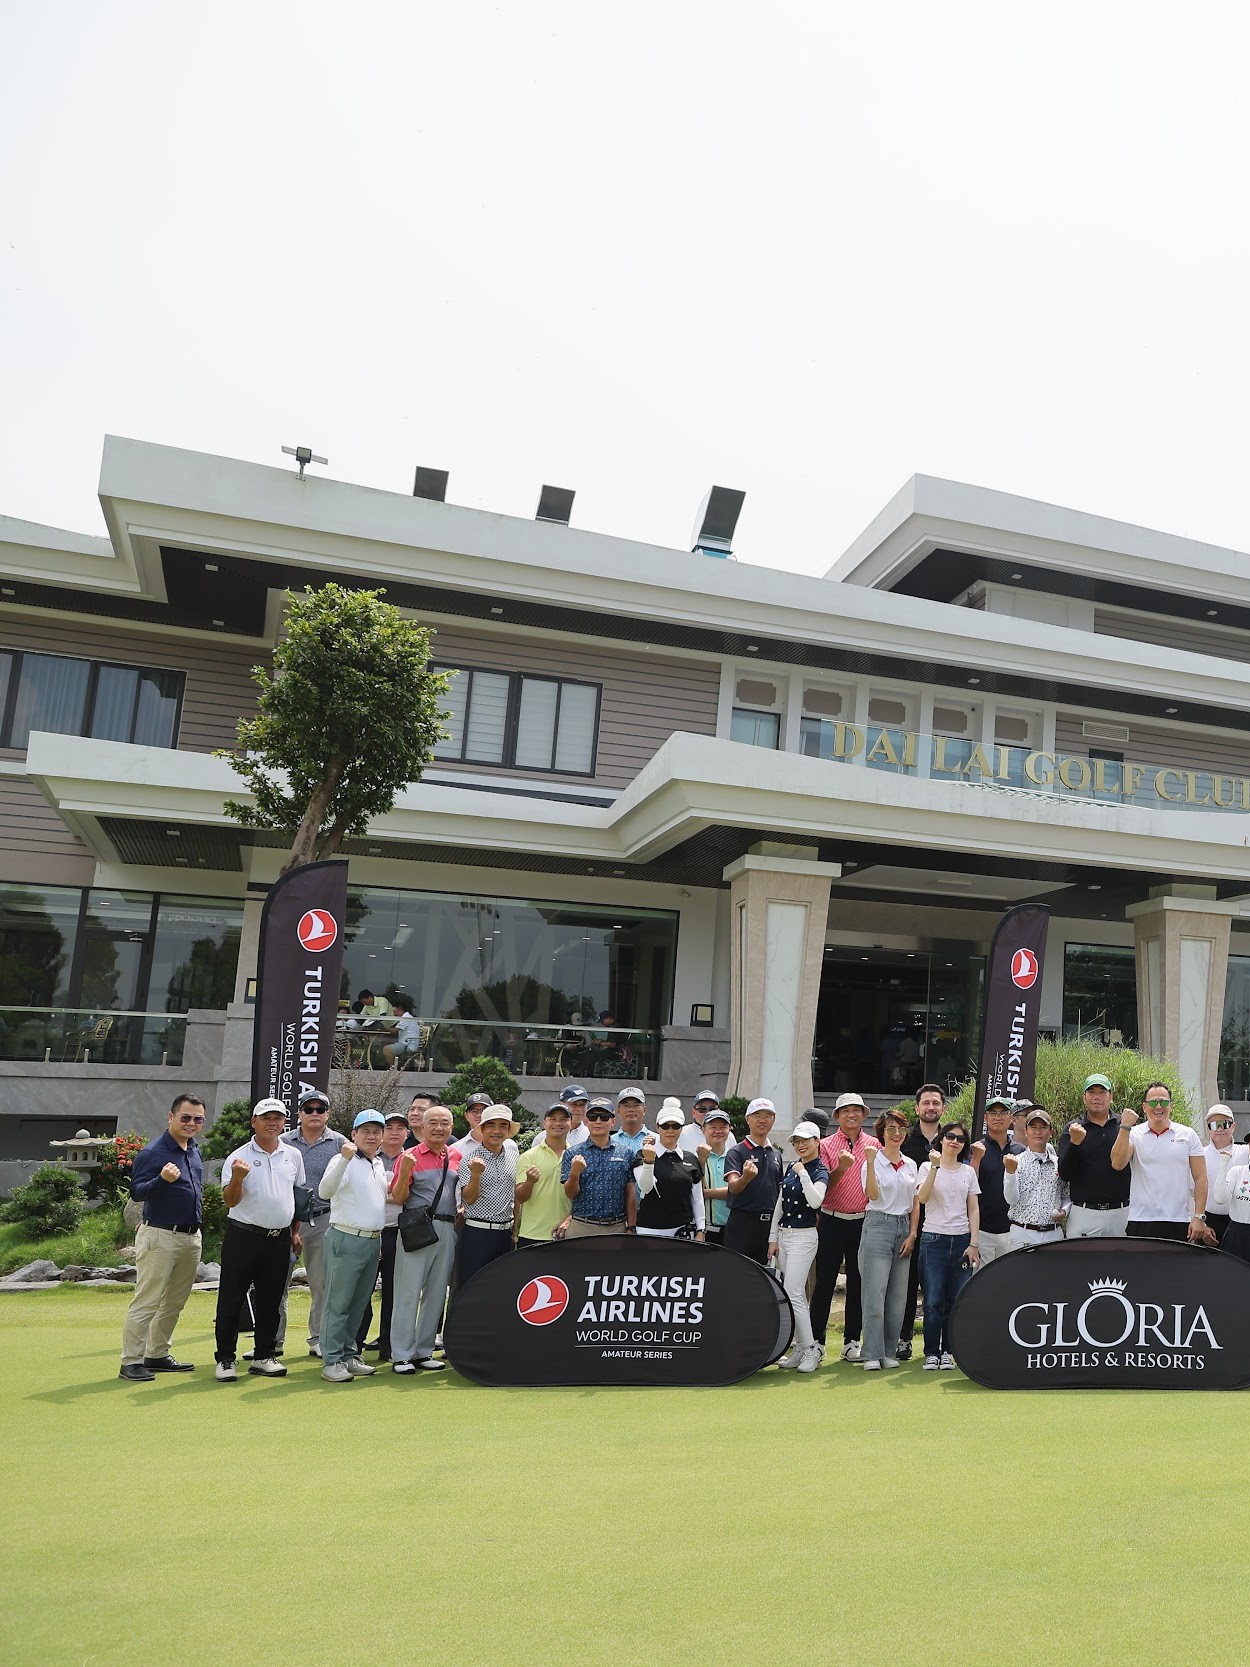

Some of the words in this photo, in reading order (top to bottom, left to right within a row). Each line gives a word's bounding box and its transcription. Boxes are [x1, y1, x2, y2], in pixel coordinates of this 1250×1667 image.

[832, 721, 918, 768] DAI
[933, 737, 1011, 780] LAI
[1024, 752, 1146, 795] GOLF
[299, 966, 323, 1073] TURKISH
[269, 1046, 278, 1085] AMATEUR
[283, 1022, 297, 1070] WORLD
[1006, 1002, 1027, 1103] TURKISH
[281, 1071, 293, 1106] GOLF
[994, 1053, 1006, 1097] WORLD
[585, 1275, 705, 1298] TURKISH
[577, 1300, 703, 1324] AIRLINES
[1008, 1291, 1224, 1350] GLORIA
[576, 1330, 629, 1342] WORLD
[631, 1330, 670, 1343] GOLF
[672, 1331, 702, 1343] CUP
[601, 1350, 642, 1359] AMATEUR
[644, 1350, 673, 1359] SERIES
[1026, 1352, 1100, 1369] HOTELS
[1104, 1351, 1120, 1367] &
[1124, 1352, 1206, 1370] RESORTS
